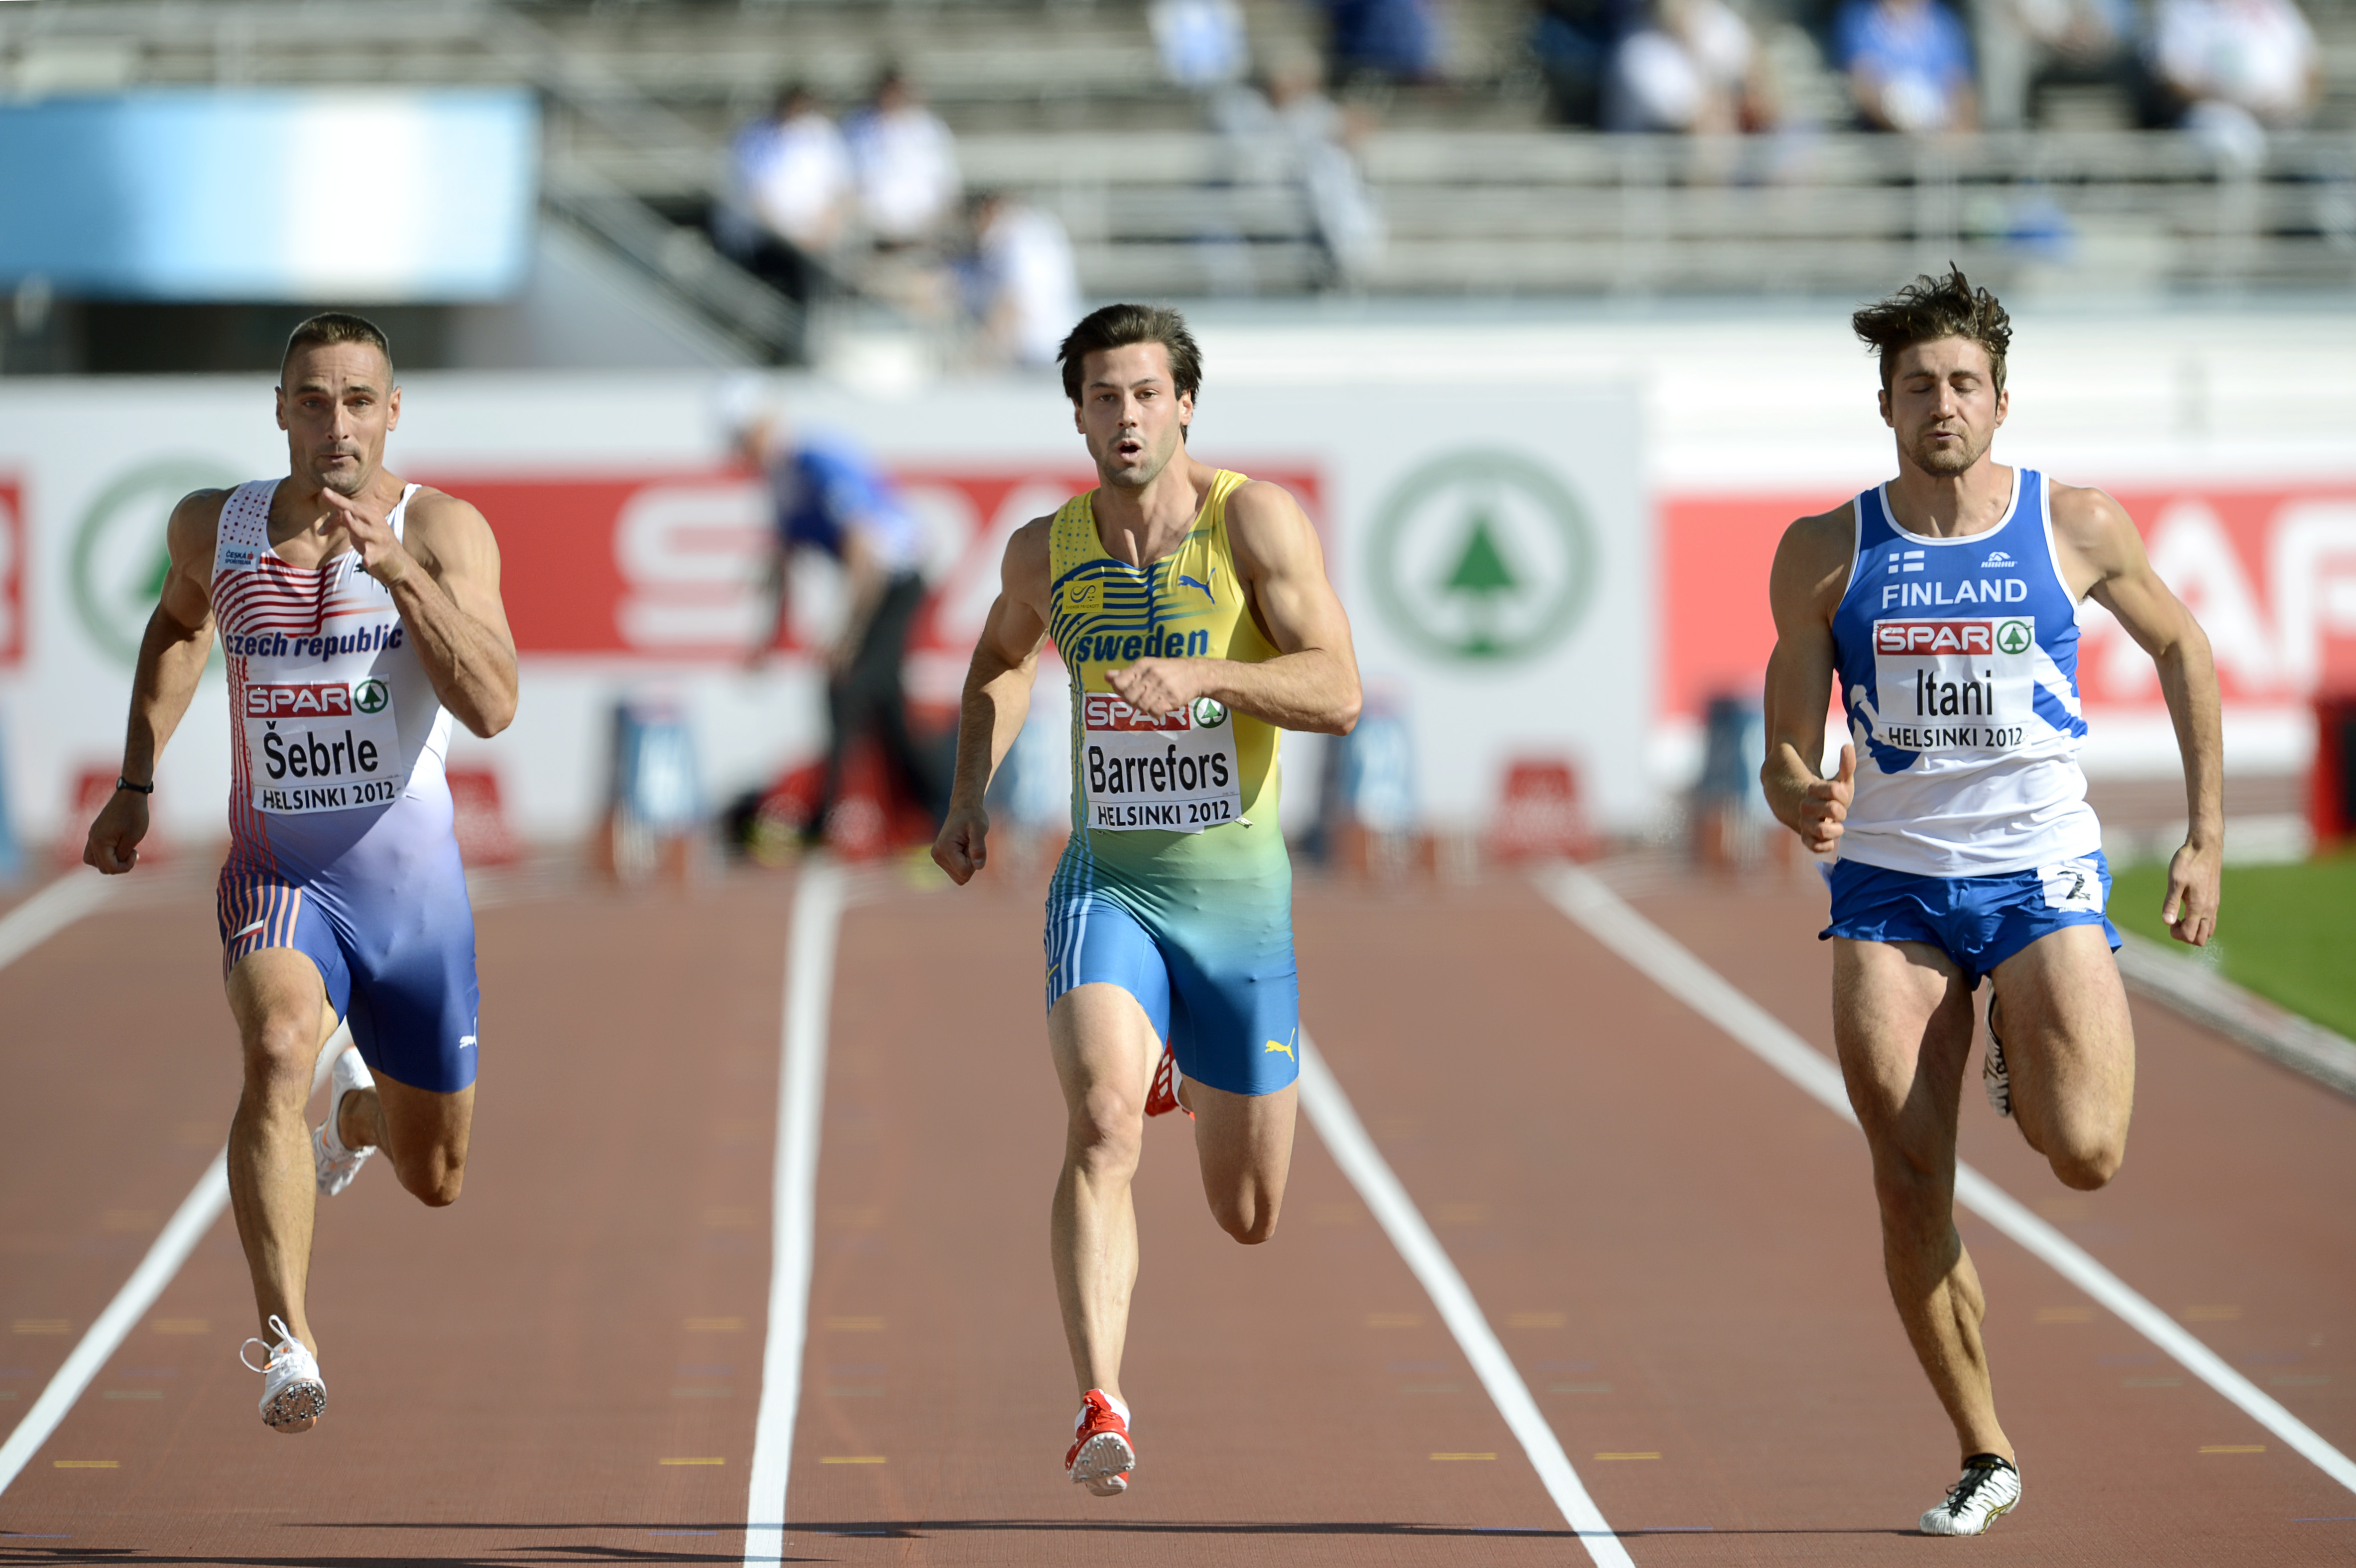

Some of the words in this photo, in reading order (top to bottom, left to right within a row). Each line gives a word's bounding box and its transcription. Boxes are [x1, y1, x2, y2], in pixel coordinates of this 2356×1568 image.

[1882, 578, 2027, 609] FINLAND
[226, 631, 288, 657] czech
[294, 624, 404, 662] republic
[1076, 624, 1208, 662] sweden
[1880, 626, 1990, 651] SPAR
[249, 688, 348, 713] SPAR
[1917, 669, 1992, 716] Itani
[263, 721, 378, 780] Šebrle
[1888, 726, 1978, 747] HELSINKI
[1985, 727, 2022, 747] 2012
[1088, 744, 1229, 794] Barrefors
[262, 787, 346, 810] HELSINKI
[353, 782, 395, 804] 2012
[1098, 805, 1180, 826] HELSINKI
[1188, 800, 1231, 822] 2012
[2057, 870, 2091, 900] 2
